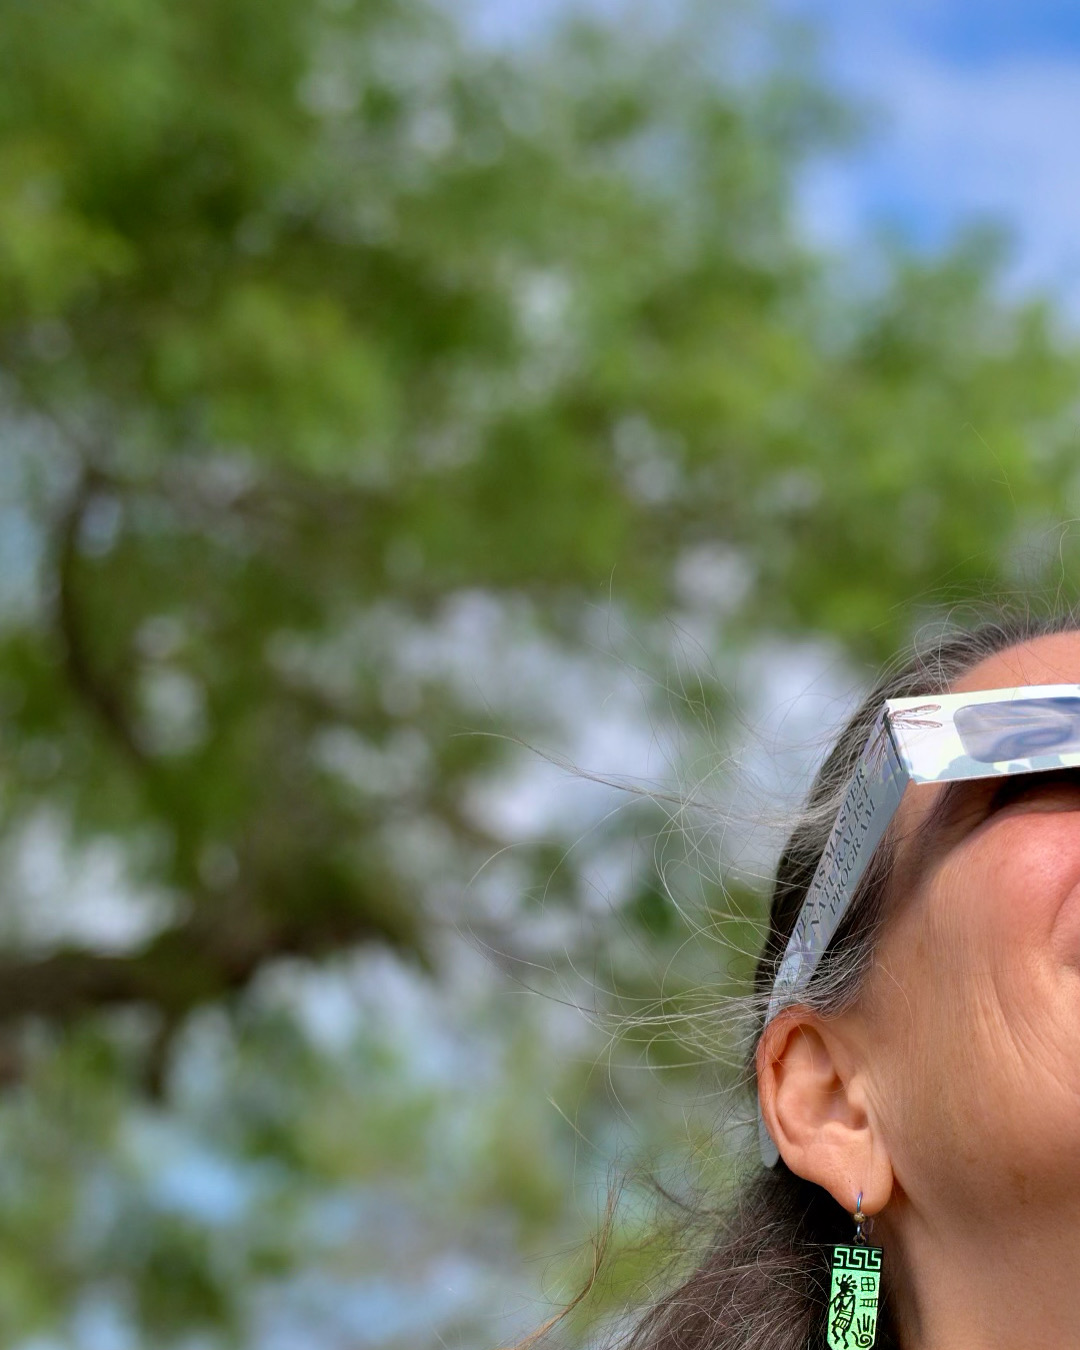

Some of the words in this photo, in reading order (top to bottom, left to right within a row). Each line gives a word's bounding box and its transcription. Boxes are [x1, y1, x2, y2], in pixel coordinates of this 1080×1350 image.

[795, 864, 826, 940] TEXAS
[824, 769, 865, 865] MASTER
[810, 780, 869, 936] NATURALIST
[829, 799, 876, 916] PROGRAM
